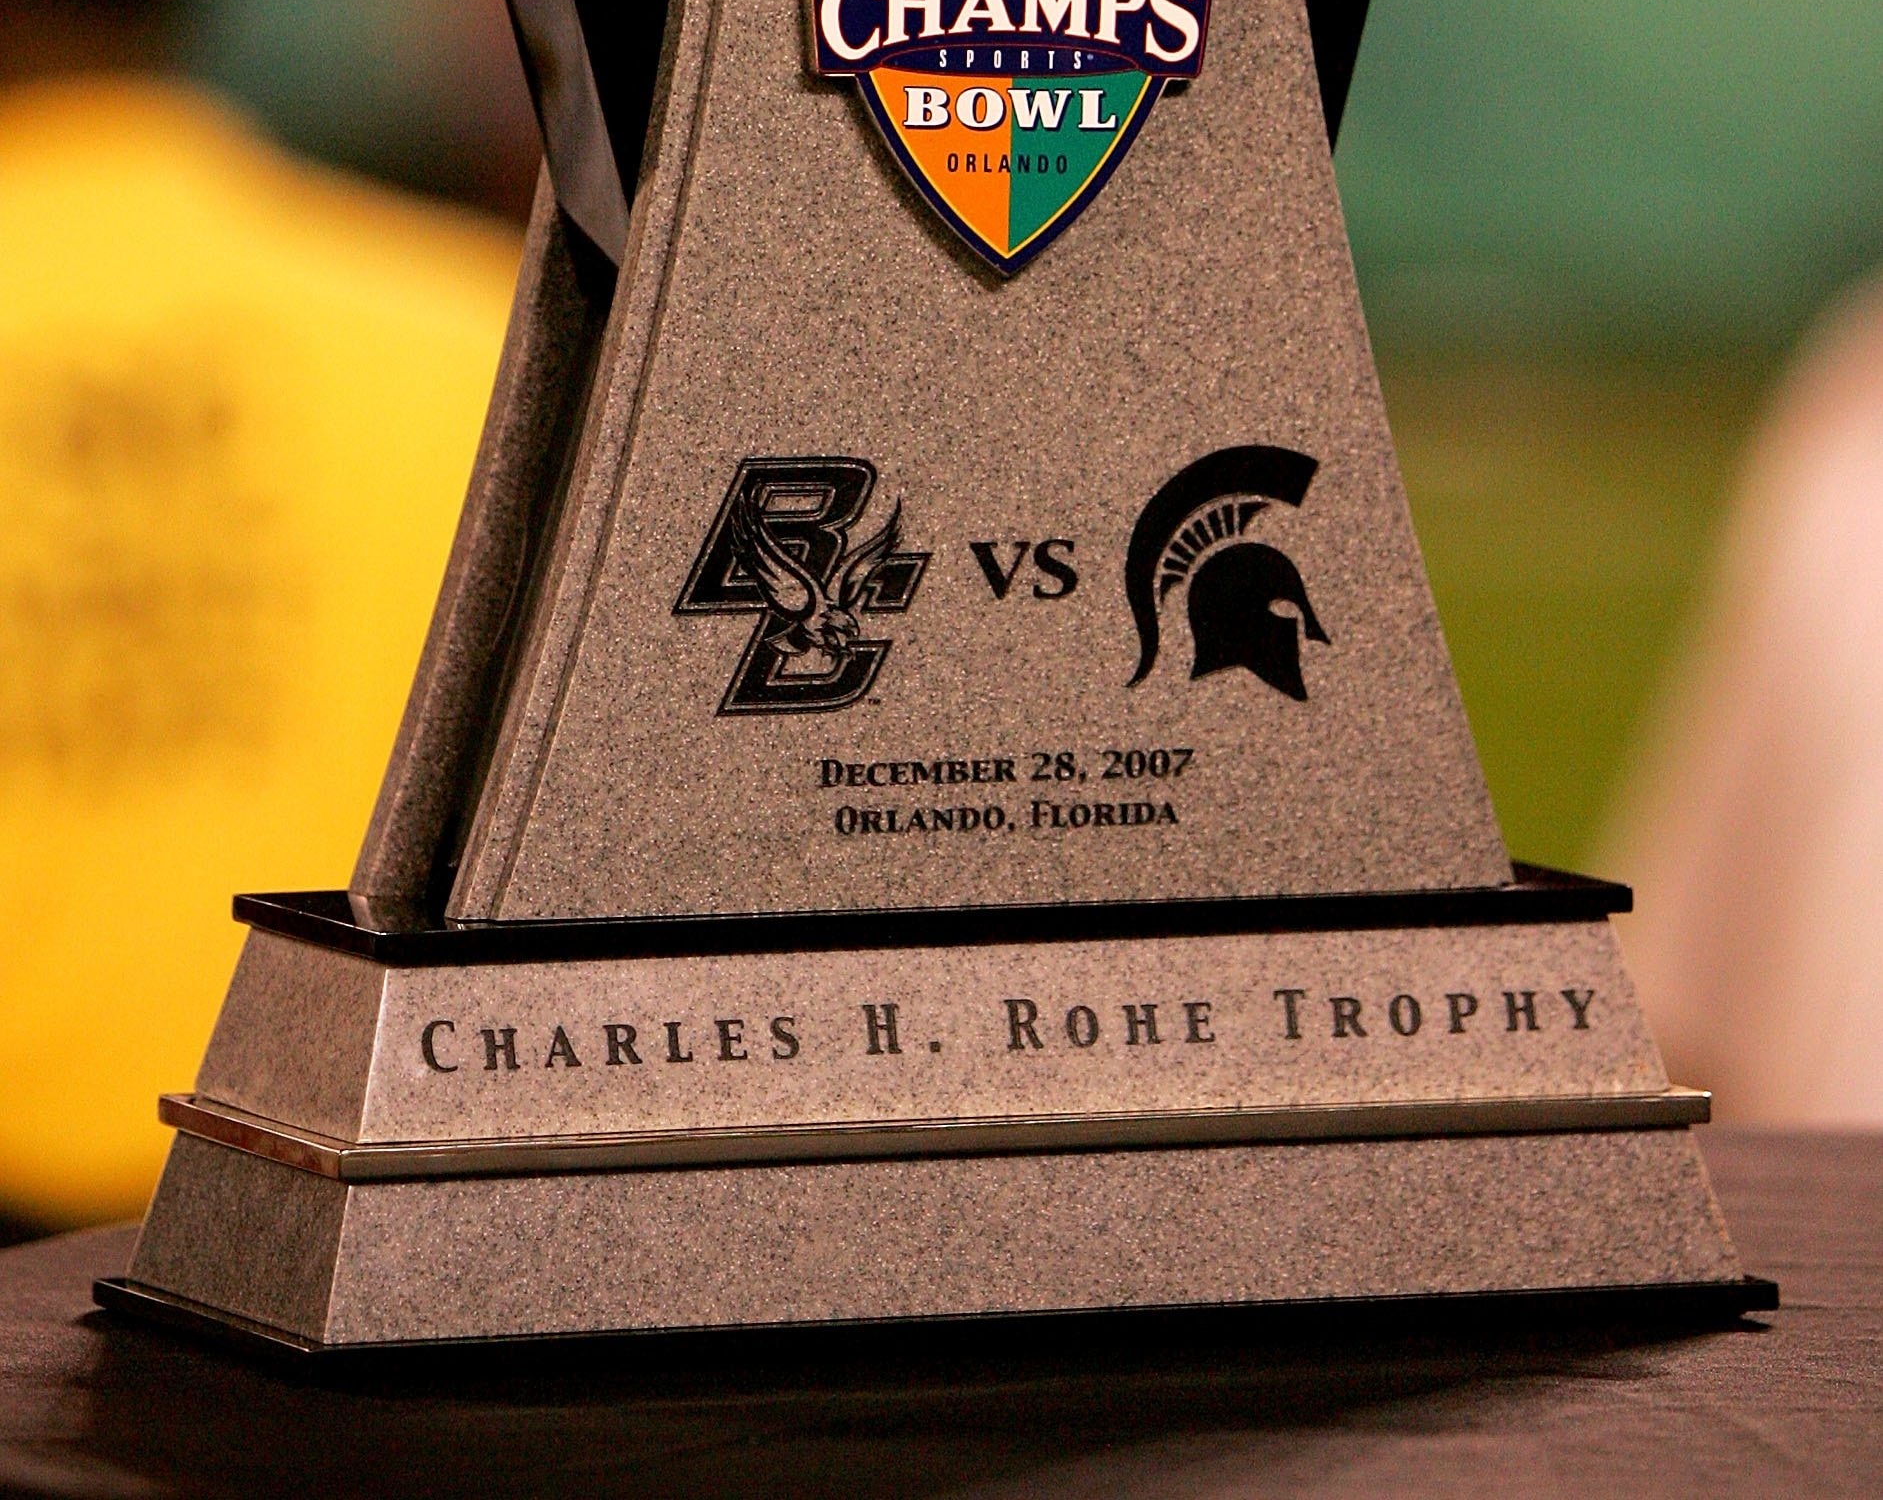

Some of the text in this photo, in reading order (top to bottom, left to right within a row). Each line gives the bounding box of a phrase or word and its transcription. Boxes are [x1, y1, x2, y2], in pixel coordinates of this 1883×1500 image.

[938, 49, 1082, 69] SPORTS
[903, 87, 1118, 129] BOWL
[947, 152, 1068, 174] ORLANDO
[969, 539, 1078, 599] VS
[818, 748, 1194, 789] DECEMBER 28, 2007
[834, 801, 1179, 836] ORLANDO, FLORIDA
[421, 988, 1594, 1073] CHARLES H. ROHE TROPHY
